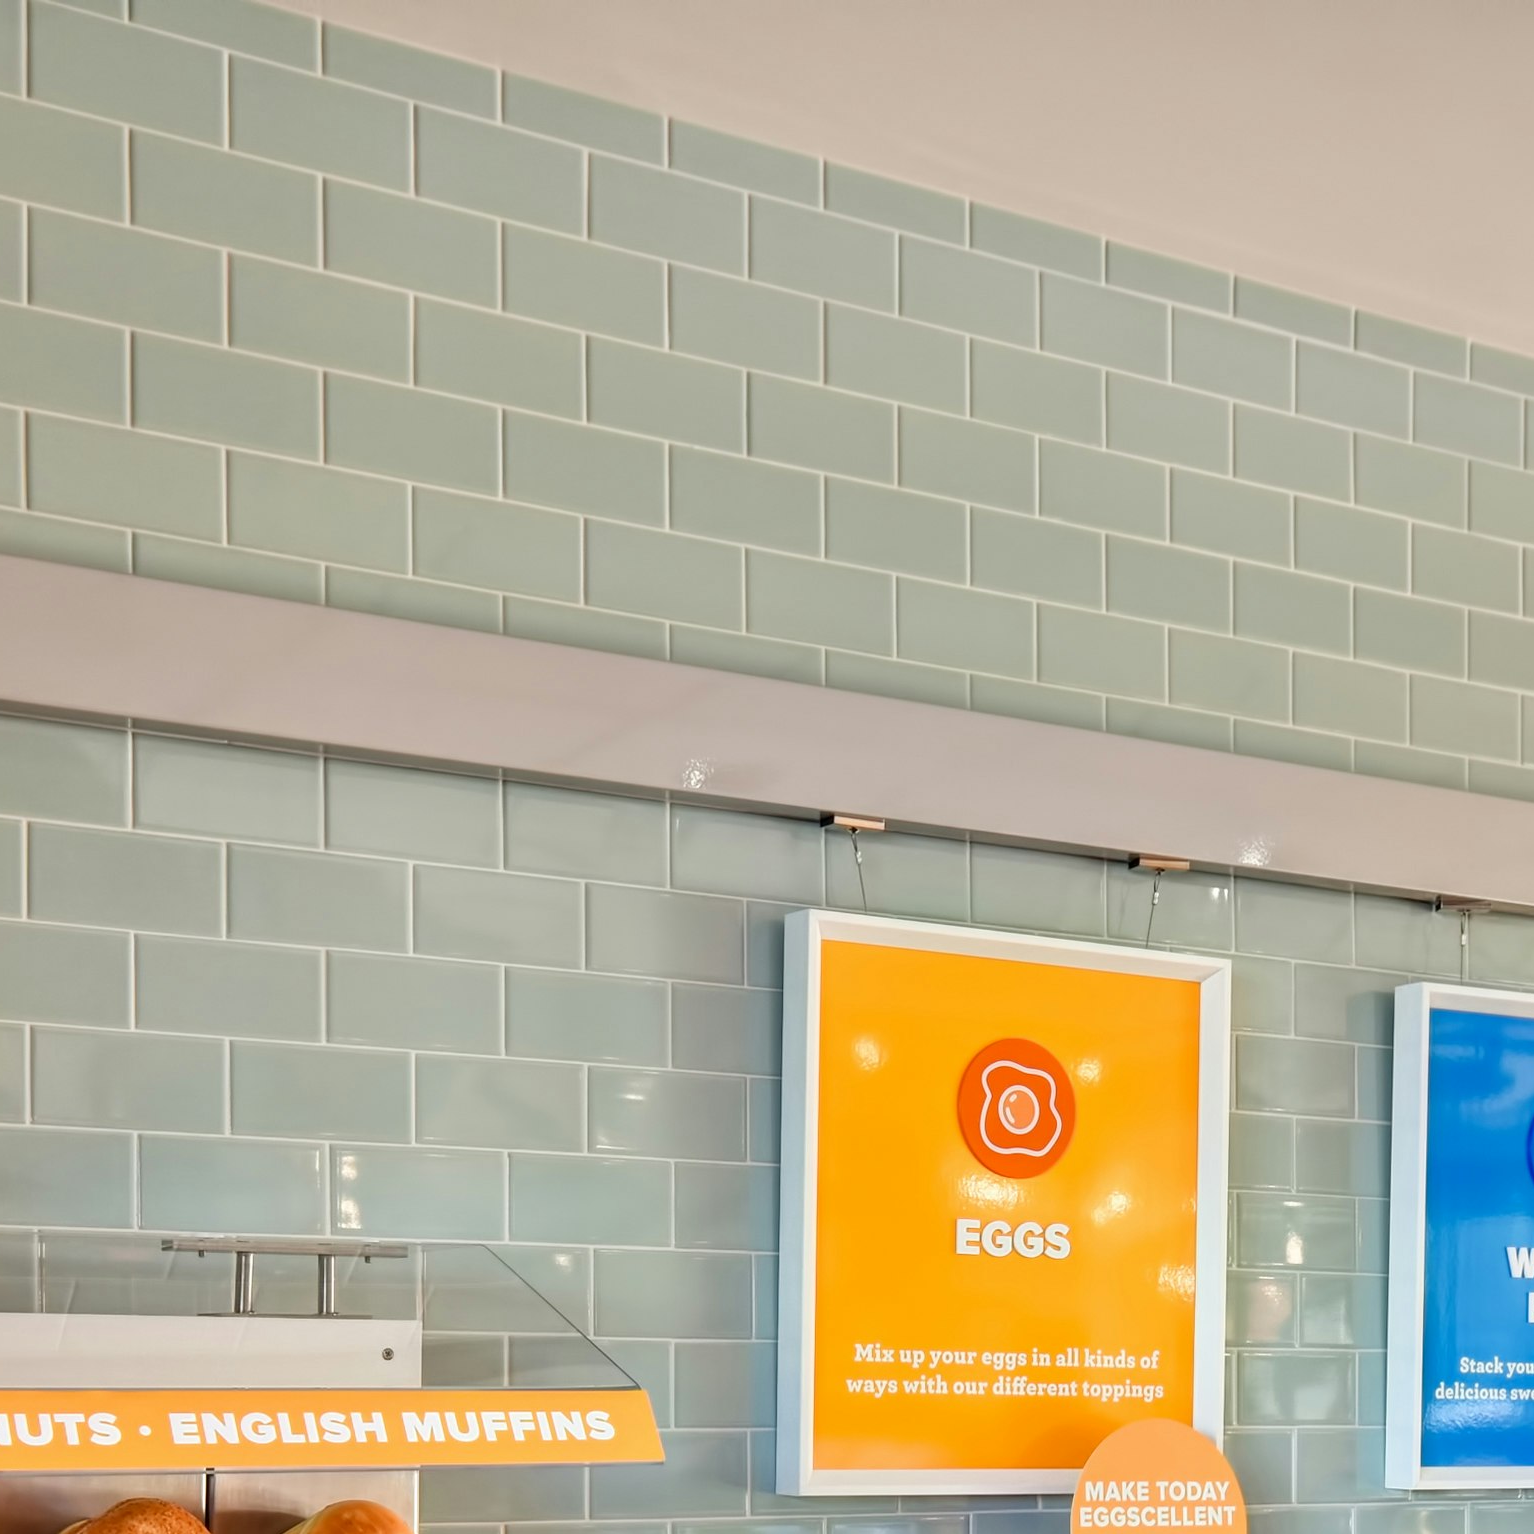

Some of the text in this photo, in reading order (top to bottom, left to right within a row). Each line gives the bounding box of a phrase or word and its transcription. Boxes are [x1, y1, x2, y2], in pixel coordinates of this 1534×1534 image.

[955, 1218, 1071, 1260] EGGS
[854, 1343, 1159, 1370] Mix up your eggs in all kinds of
[1460, 1356, 1504, 1374] Stack
[846, 1375, 1163, 1402] ways with our different toppings
[1434, 1382, 1507, 1400] delicious
[168, 1411, 388, 1444] ENGLISH
[402, 1410, 615, 1442] MUFFINS
[1085, 1481, 1230, 1501] MAKE TODAY
[1079, 1506, 1236, 1528] EGGSCELLENT
